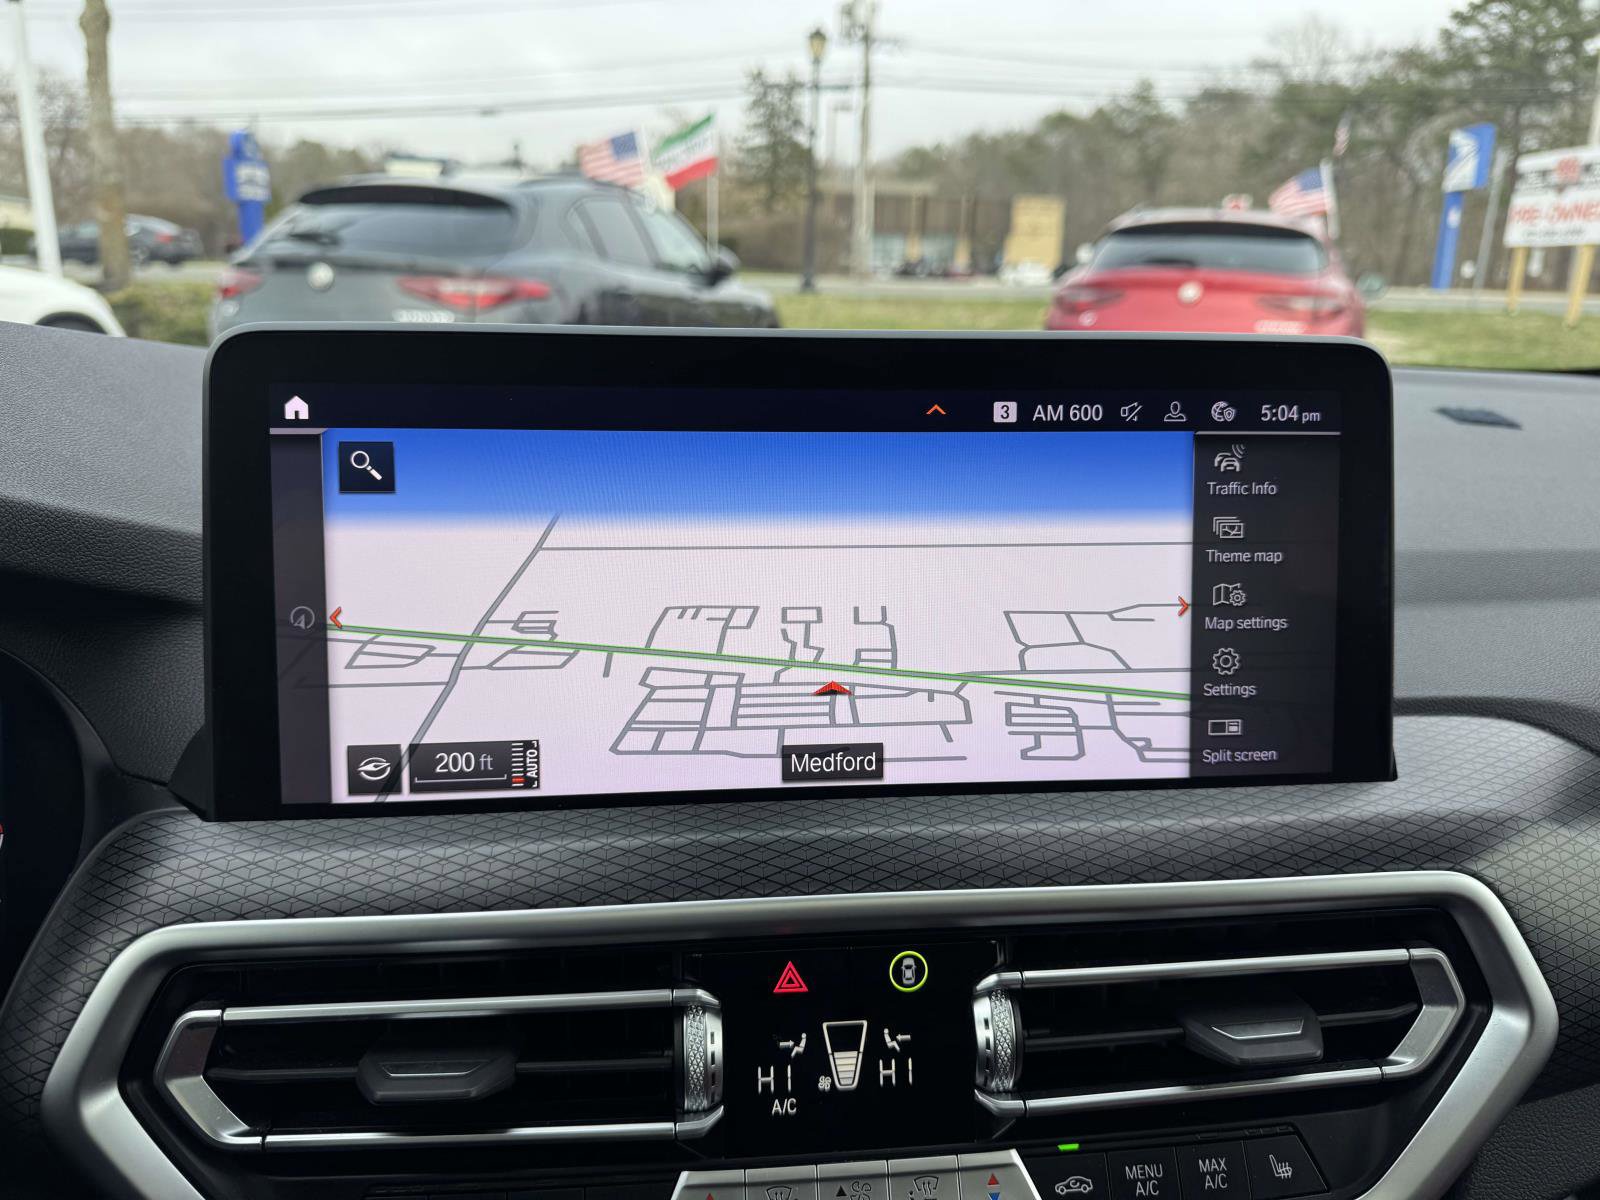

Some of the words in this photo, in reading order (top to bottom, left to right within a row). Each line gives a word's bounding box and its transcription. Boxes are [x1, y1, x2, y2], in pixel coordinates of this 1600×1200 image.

[1000, 404, 1010, 420] 3
[1033, 404, 1064, 421] AM
[1069, 404, 1103, 421] 600
[1261, 404, 1298, 422] 5:04
[1301, 412, 1321, 424] pm
[1207, 481, 1249, 496] Traffic
[1252, 481, 1278, 496] Info
[1206, 549, 1251, 563] Theme
[1253, 551, 1283, 564] map
[1204, 616, 1234, 631] Map
[1236, 616, 1289, 631] settings
[1203, 683, 1257, 698] Settings
[434, 751, 476, 773] 200
[479, 753, 494, 771] ft
[526, 749, 538, 779] AUTO
[791, 751, 877, 773] Medford
[1202, 748, 1233, 764] Split
[1233, 749, 1278, 762] screen
[771, 1097, 798, 1116] A/C
[1125, 1163, 1164, 1180] MENU
[1198, 1157, 1228, 1173] MAX
[1135, 1180, 1160, 1197] A/C
[1204, 1173, 1228, 1190] A/C
